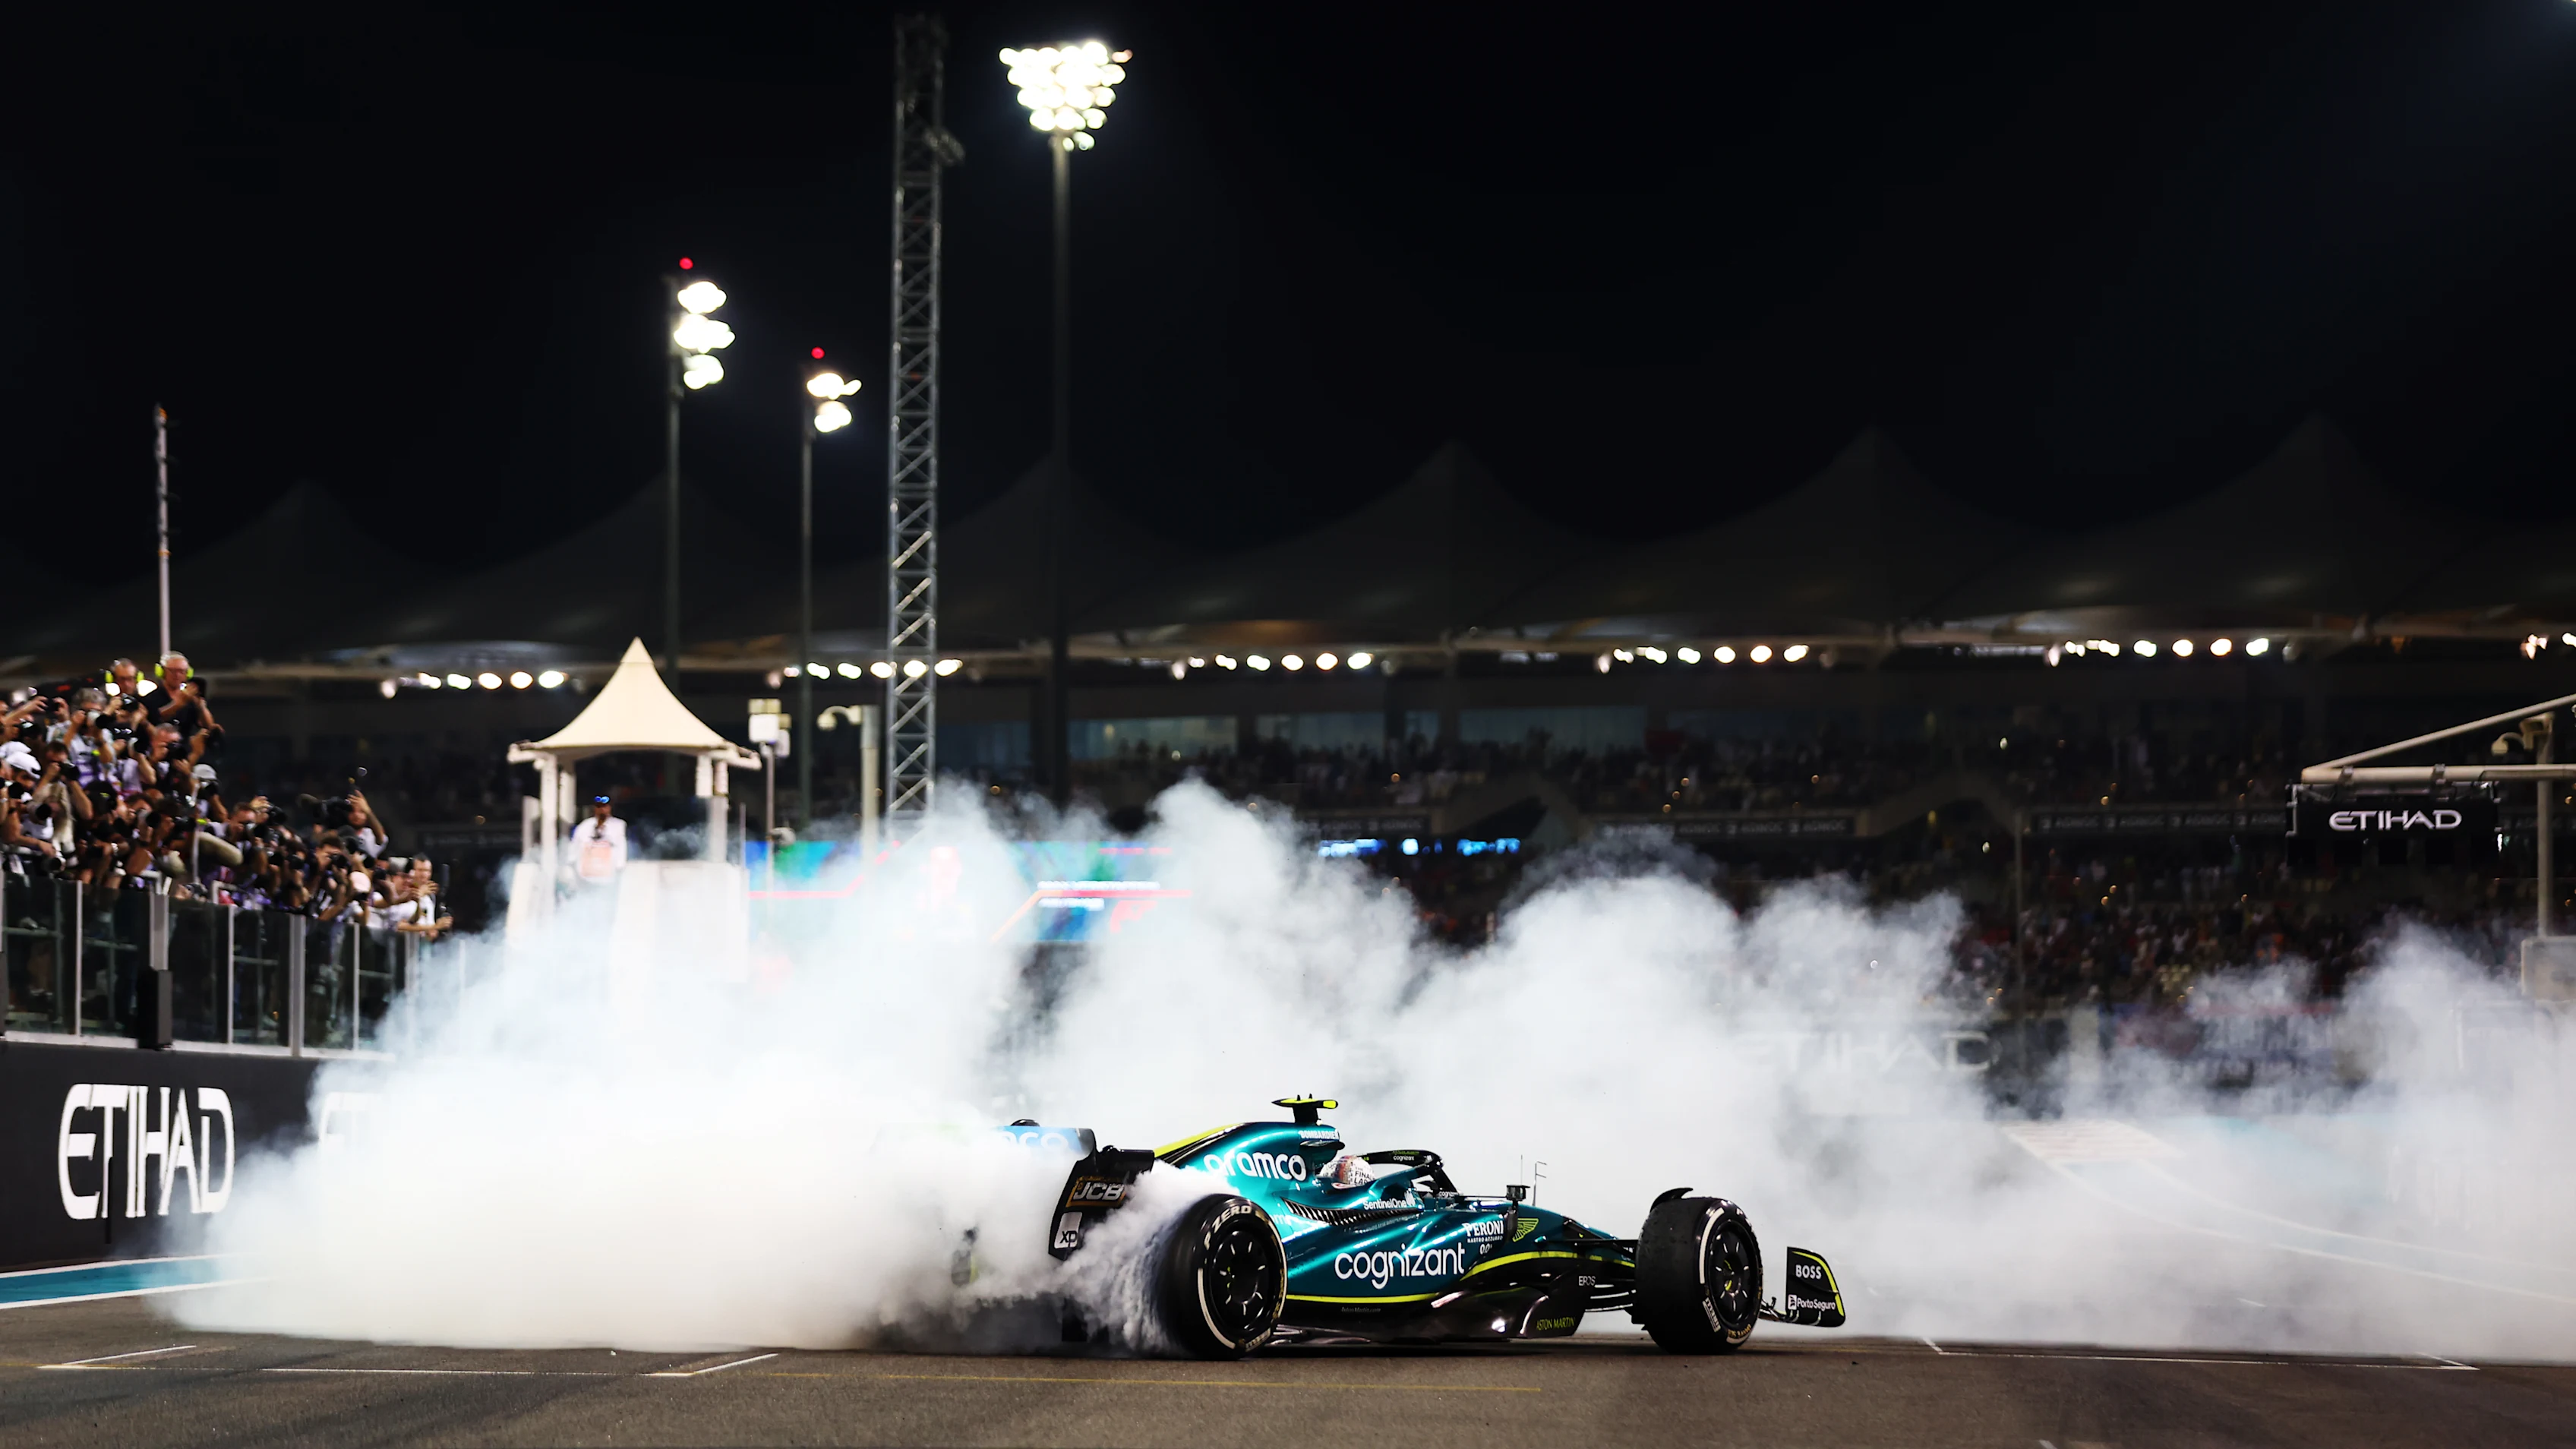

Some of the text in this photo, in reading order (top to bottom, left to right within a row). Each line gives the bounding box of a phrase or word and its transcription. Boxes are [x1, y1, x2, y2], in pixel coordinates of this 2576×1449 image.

[2329, 810, 2462, 831] ETIHAD
[1298, 1129, 1339, 1139] BOMBARDIER
[58, 1083, 235, 1220] ETIHAD
[1203, 1151, 1307, 1181] aramco
[1072, 1181, 1125, 1201] JCB
[1363, 1198, 1406, 1210] SentinelOne
[1212, 1205, 1252, 1234] ZERO
[1462, 1220, 1504, 1237] PERONI
[1334, 1242, 1466, 1290] cognizant
[1795, 1264, 1822, 1279] BOSS
[1536, 1316, 1576, 1331] ASTON MARTIN
